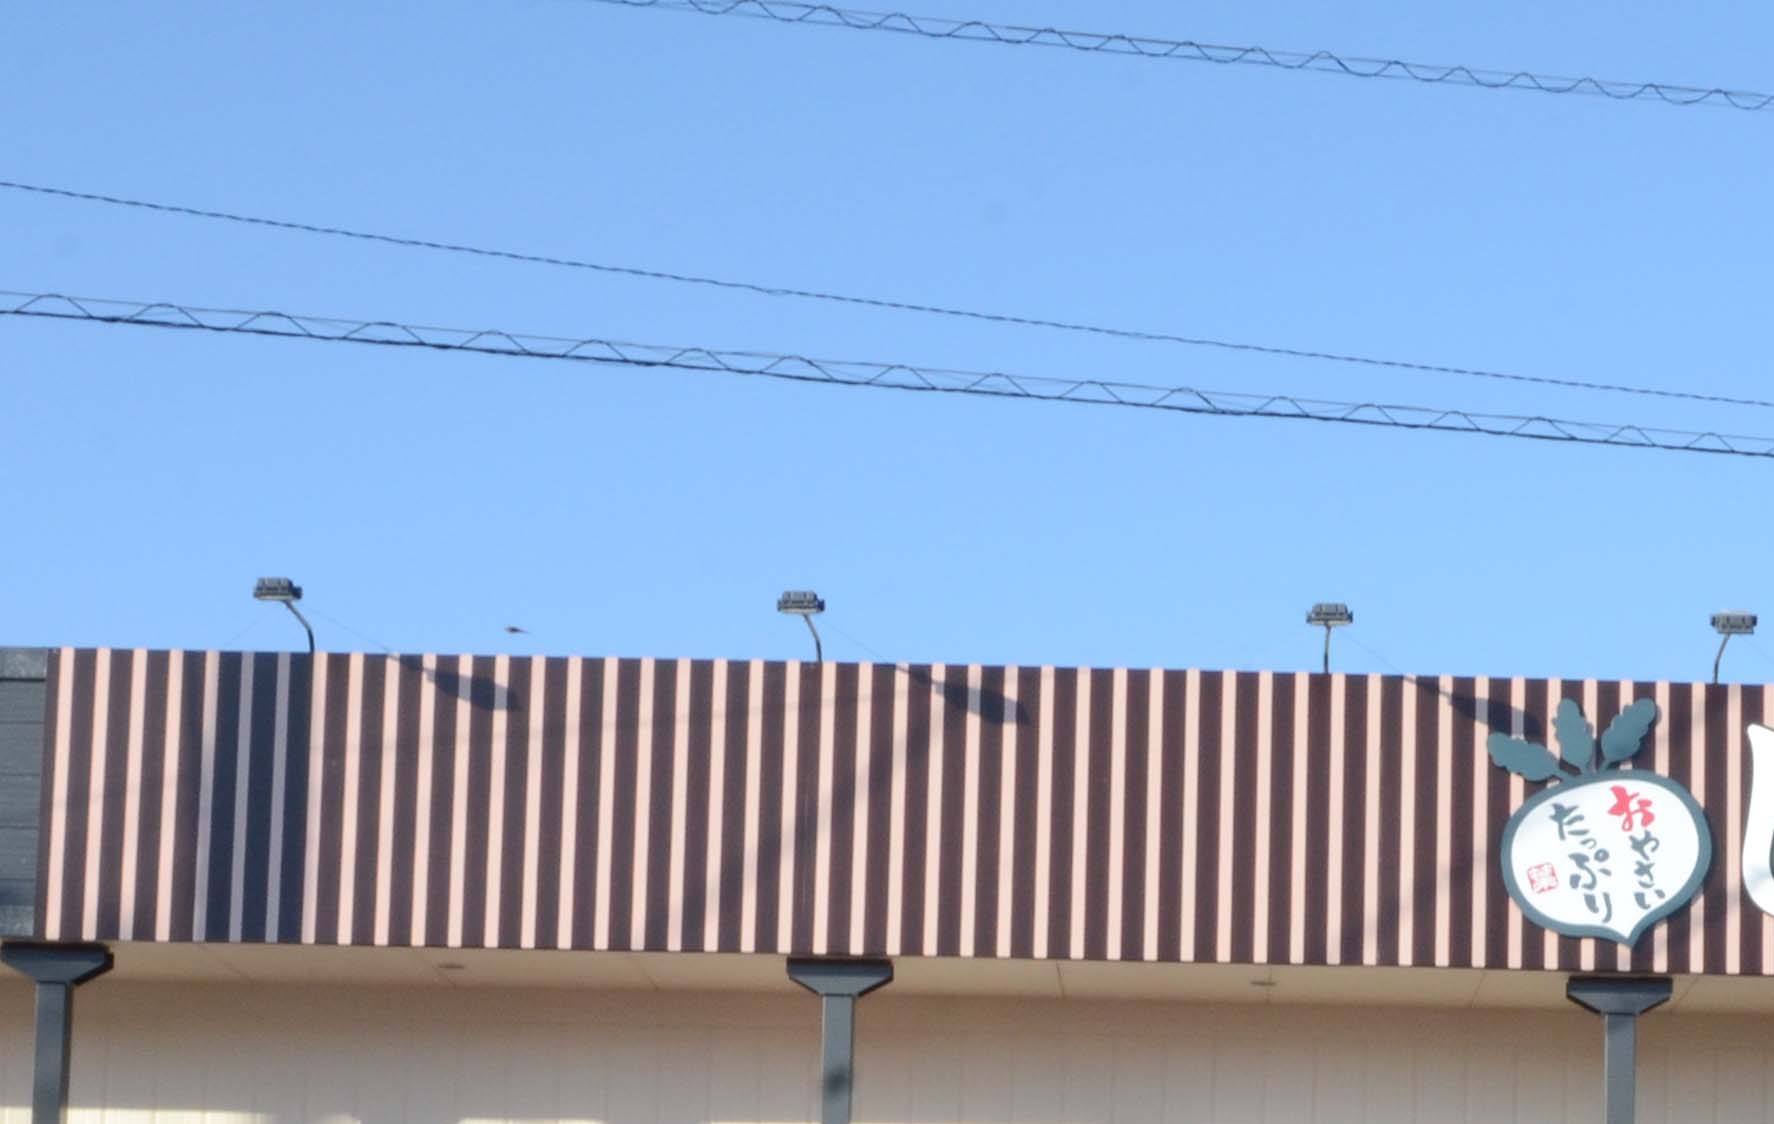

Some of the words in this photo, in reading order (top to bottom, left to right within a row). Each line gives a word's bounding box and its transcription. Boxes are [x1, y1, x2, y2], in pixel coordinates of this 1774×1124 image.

[1549, 803, 1613, 924] たっぷり
[1607, 785, 1667, 911] おやさい
